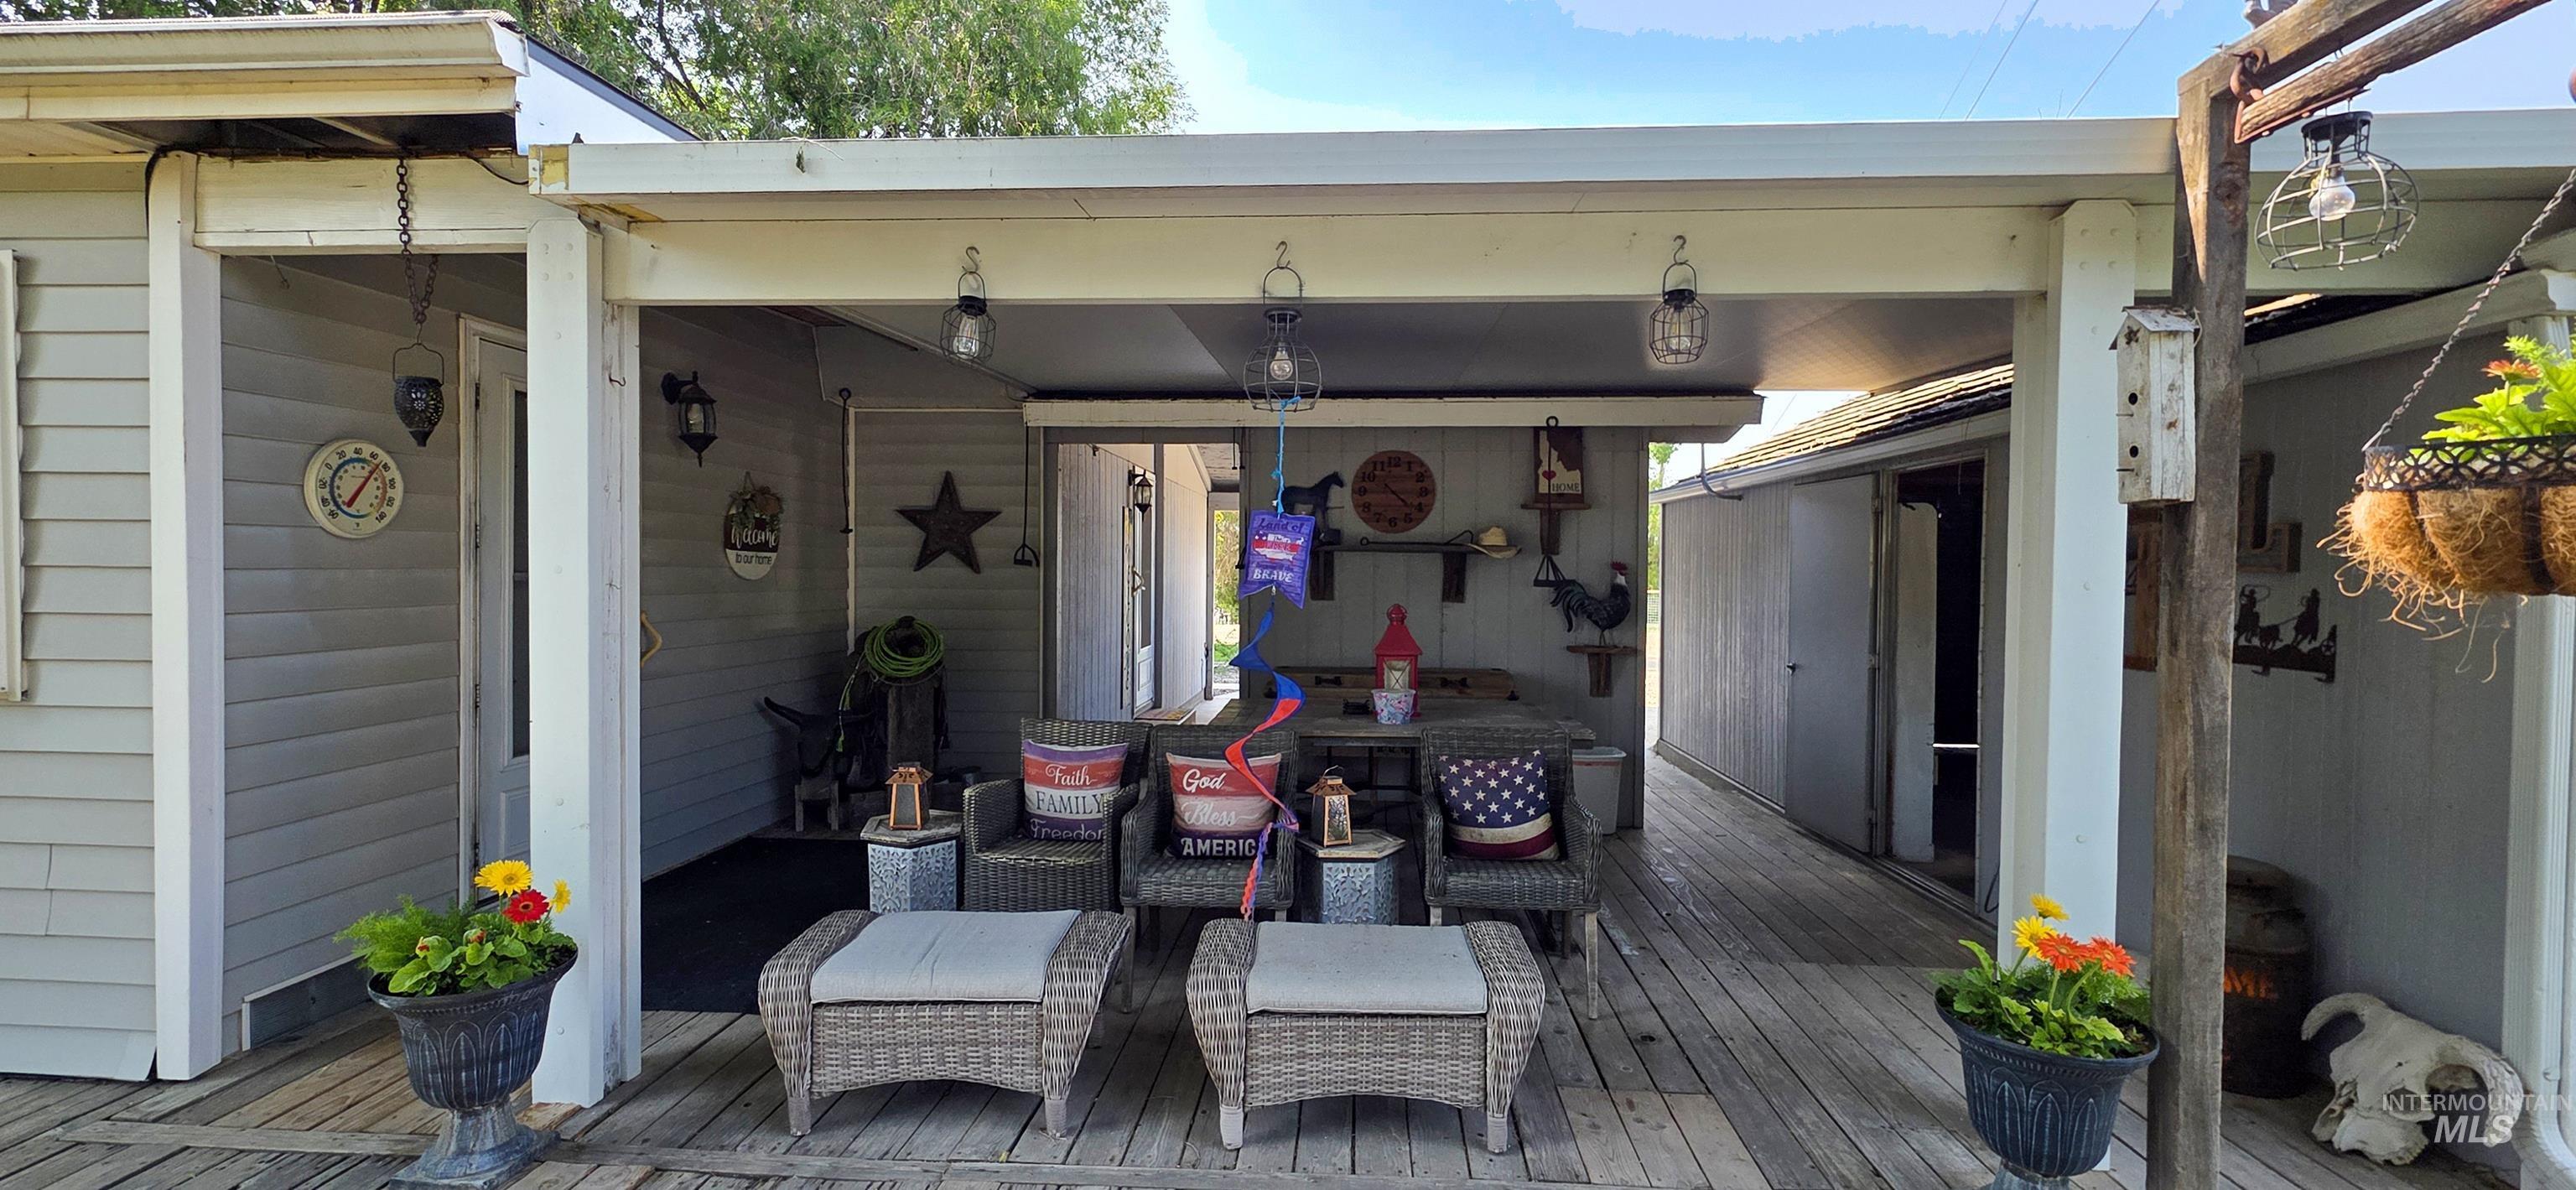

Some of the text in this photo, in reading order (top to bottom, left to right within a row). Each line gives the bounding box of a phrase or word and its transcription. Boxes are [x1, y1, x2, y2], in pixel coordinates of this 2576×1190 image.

[336, 449, 347, 460] 20
[353, 447, 363, 455] 40
[369, 451, 379, 460] 60
[325, 462, 333, 470] 0
[1373, 460, 1385, 471] 11
[1387, 455, 1401, 468] 12
[1406, 460, 1413, 471] 1
[1361, 470, 1376, 482] 10
[1415, 471, 1426, 483] 2
[1358, 486, 1368, 496] 9
[1419, 486, 1429, 497] 3
[1551, 482, 1580, 492] HOME
[1362, 501, 1371, 512] 8
[1414, 501, 1424, 512] 4
[375, 511, 387, 523] 140
[1374, 512, 1382, 522] 7
[1388, 517, 1397, 527] 6
[1404, 512, 1413, 523] 5
[1258, 518, 1306, 533] Land of
[735, 553, 772, 565] to our home
[1253, 569, 1295, 583] BRAVE
[1046, 763, 1098, 786] Faith
[1182, 768, 1227, 792] God
[1036, 790, 1104, 815] FAMILY
[1181, 800, 1259, 827] Bless
[1181, 837, 1268, 857] AMERIC
